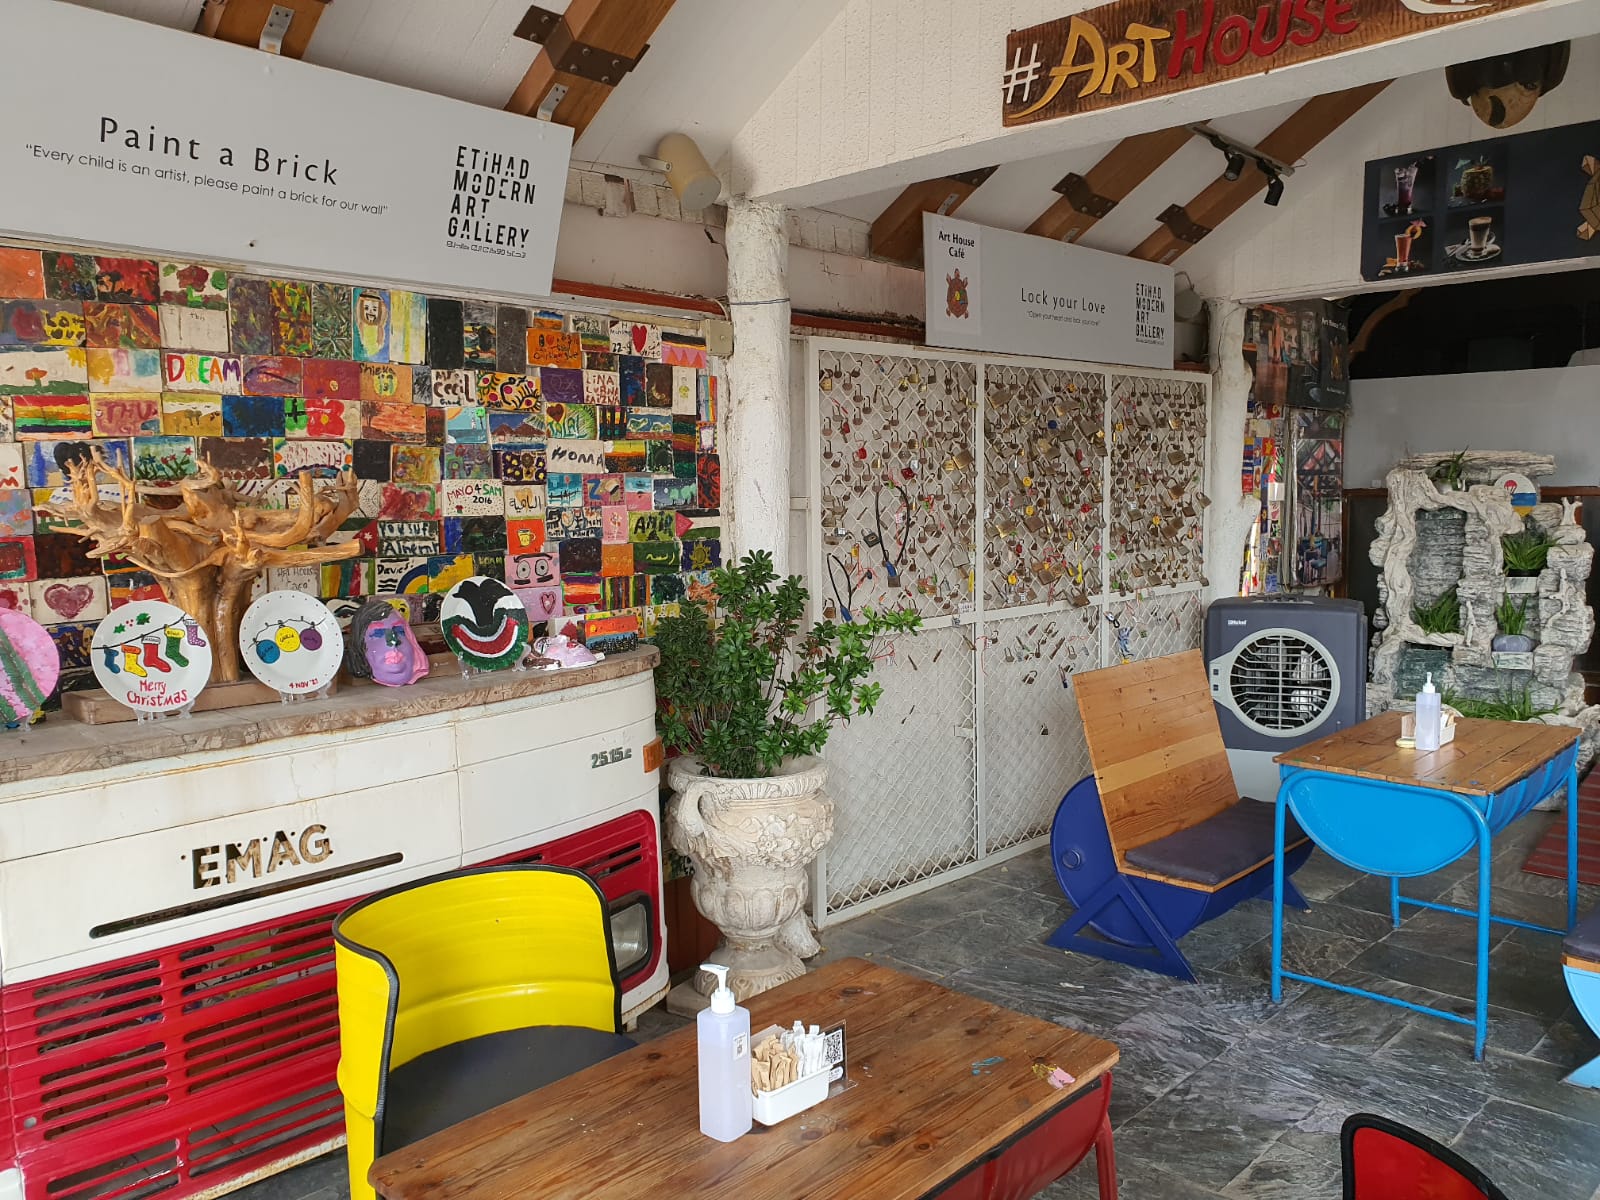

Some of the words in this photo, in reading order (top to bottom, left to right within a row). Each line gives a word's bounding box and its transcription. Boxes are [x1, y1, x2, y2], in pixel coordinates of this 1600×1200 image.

[100, 117, 200, 160] Paint
[219, 147, 234, 167] a
[254, 147, 338, 185] Brick
[78, 154, 114, 170] child
[118, 159, 127, 172] is
[131, 164, 150, 176] an
[194, 174, 238, 191] please
[242, 183, 274, 197] paint
[278, 189, 287, 200] a
[290, 189, 318, 205] brick
[321, 195, 337, 208] for
[339, 200, 359, 211] our
[453, 169, 536, 205] MODERN
[450, 193, 490, 219] ART
[447, 216, 530, 249] GALLERY
[938, 230, 950, 243] Art
[952, 232, 975, 248] House
[1021, 287, 1048, 305] Lock
[1052, 295, 1078, 310] your
[1082, 297, 1106, 314] Love
[1135, 296, 1165, 313] MODERN
[1135, 310, 1149, 325] ART
[166, 354, 240, 384] DREAM
[472, 495, 493, 504] 2016
[482, 483, 502, 496] SAM
[139, 680, 167, 695] Merry
[192, 823, 331, 890] EMAG
